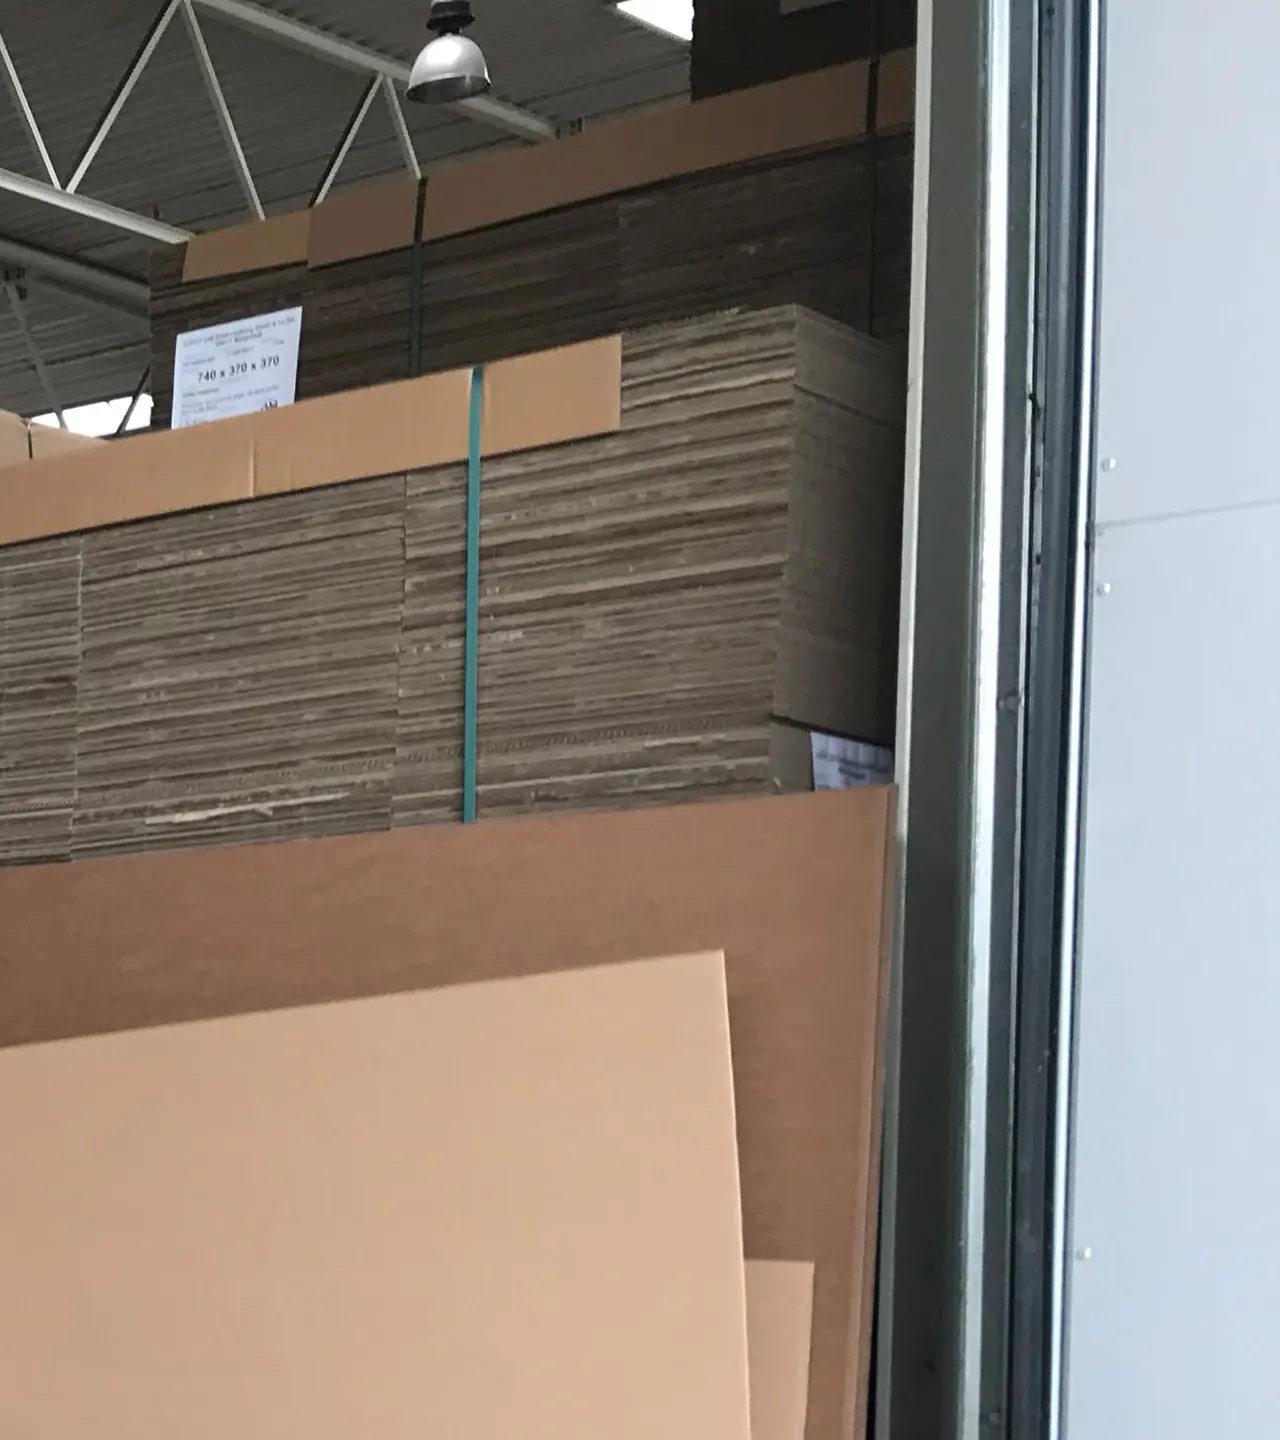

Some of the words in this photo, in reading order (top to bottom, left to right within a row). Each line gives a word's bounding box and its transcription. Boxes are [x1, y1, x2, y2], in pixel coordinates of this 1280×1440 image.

[197, 369, 217, 382] 740
[229, 362, 248, 376] 370
[261, 355, 280, 368] 370
